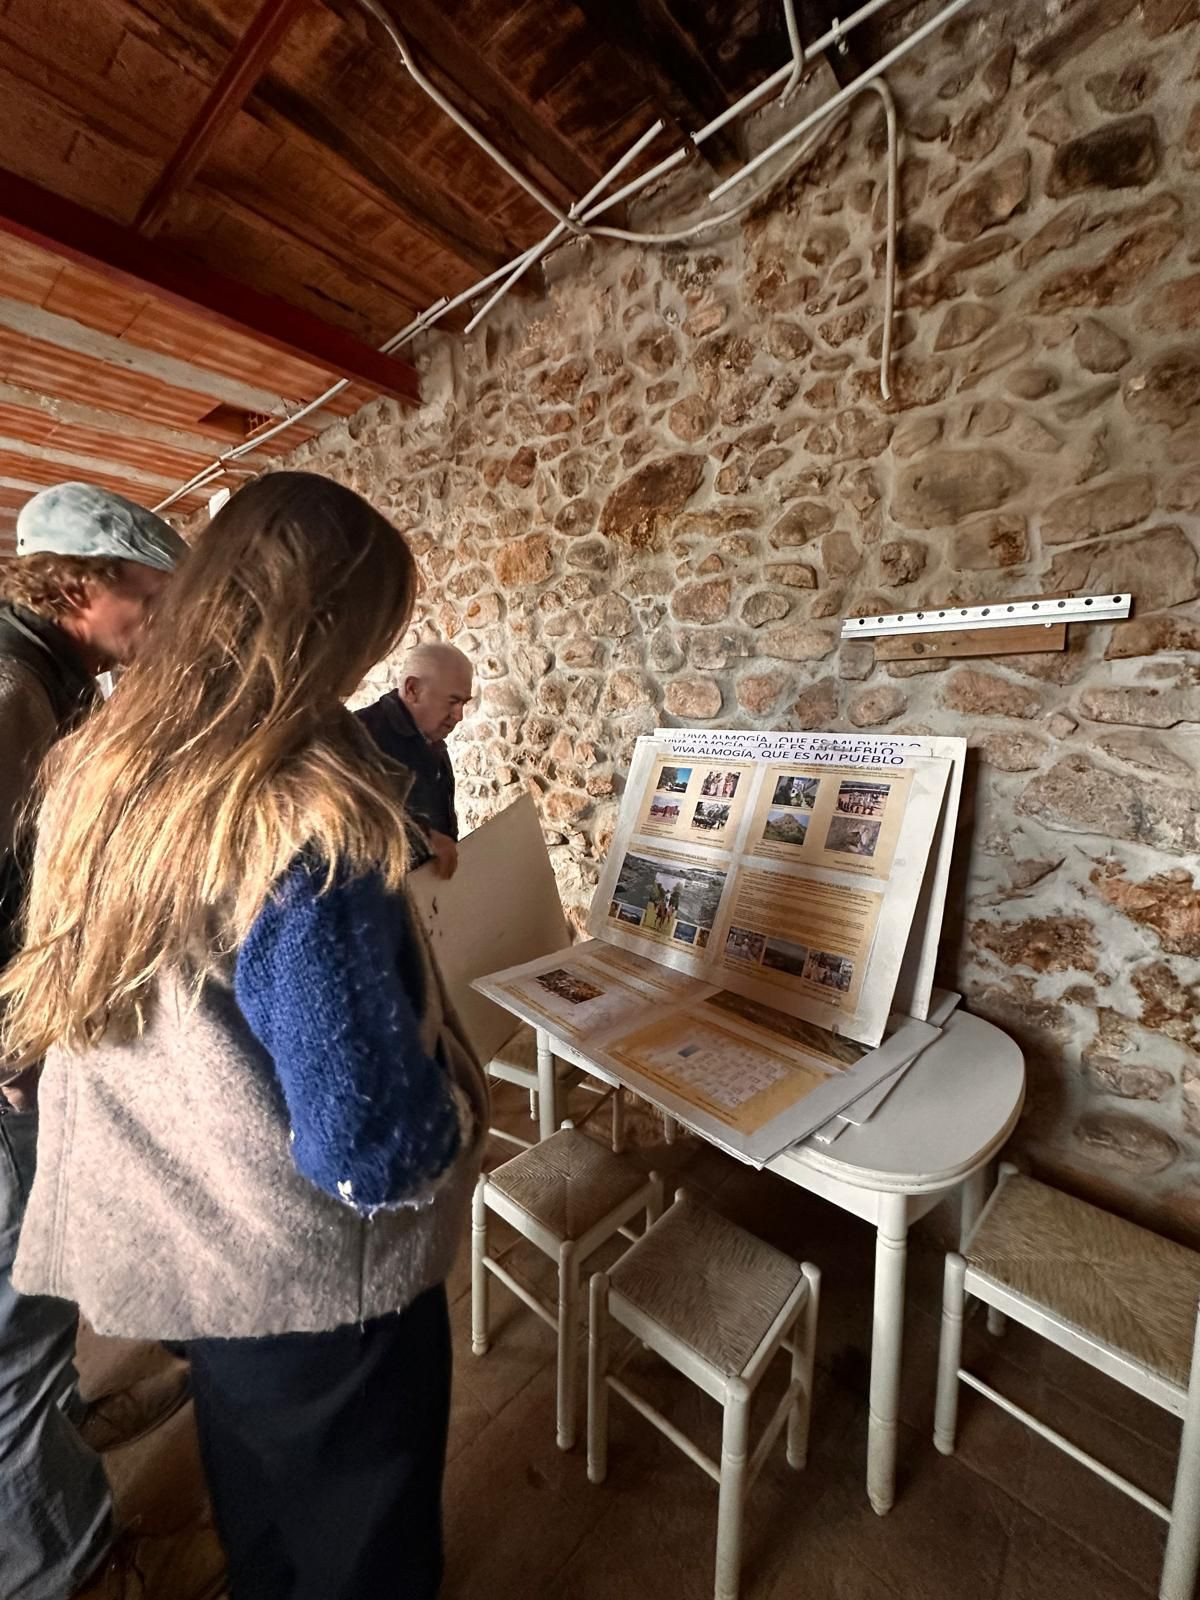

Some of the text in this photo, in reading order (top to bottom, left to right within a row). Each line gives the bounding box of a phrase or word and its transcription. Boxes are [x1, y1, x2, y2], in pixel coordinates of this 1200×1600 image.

[672, 745, 695, 754] VIVA
[697, 747, 756, 760] ALMOGÍA,
[761, 750, 790, 759] QUE
[794, 751, 810, 760] ES
[814, 752, 834, 761] MI
[839, 754, 904, 765] PUEBLO
